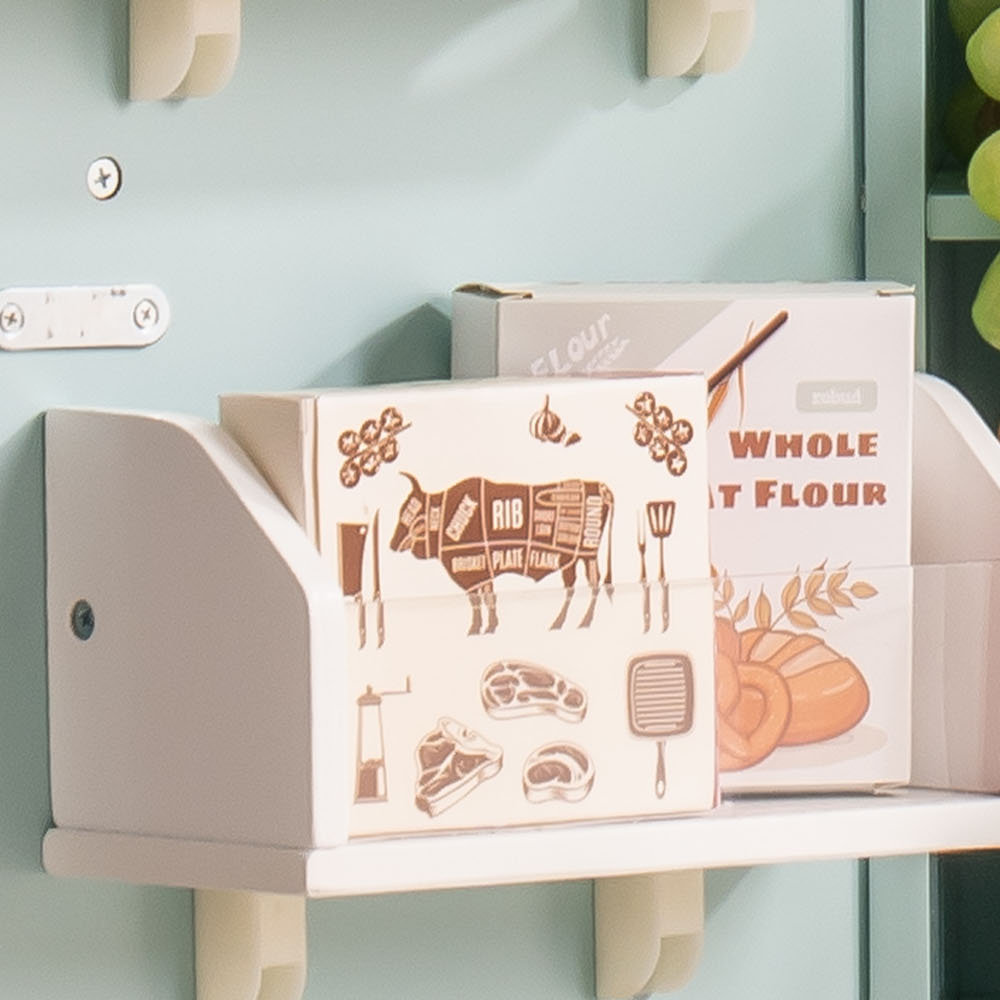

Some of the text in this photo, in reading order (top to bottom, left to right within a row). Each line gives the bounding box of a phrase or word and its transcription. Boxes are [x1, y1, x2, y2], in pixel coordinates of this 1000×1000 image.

[493, 497, 524, 531] RIB
[582, 495, 604, 549] ROUND
[492, 547, 525, 572] PLATE
